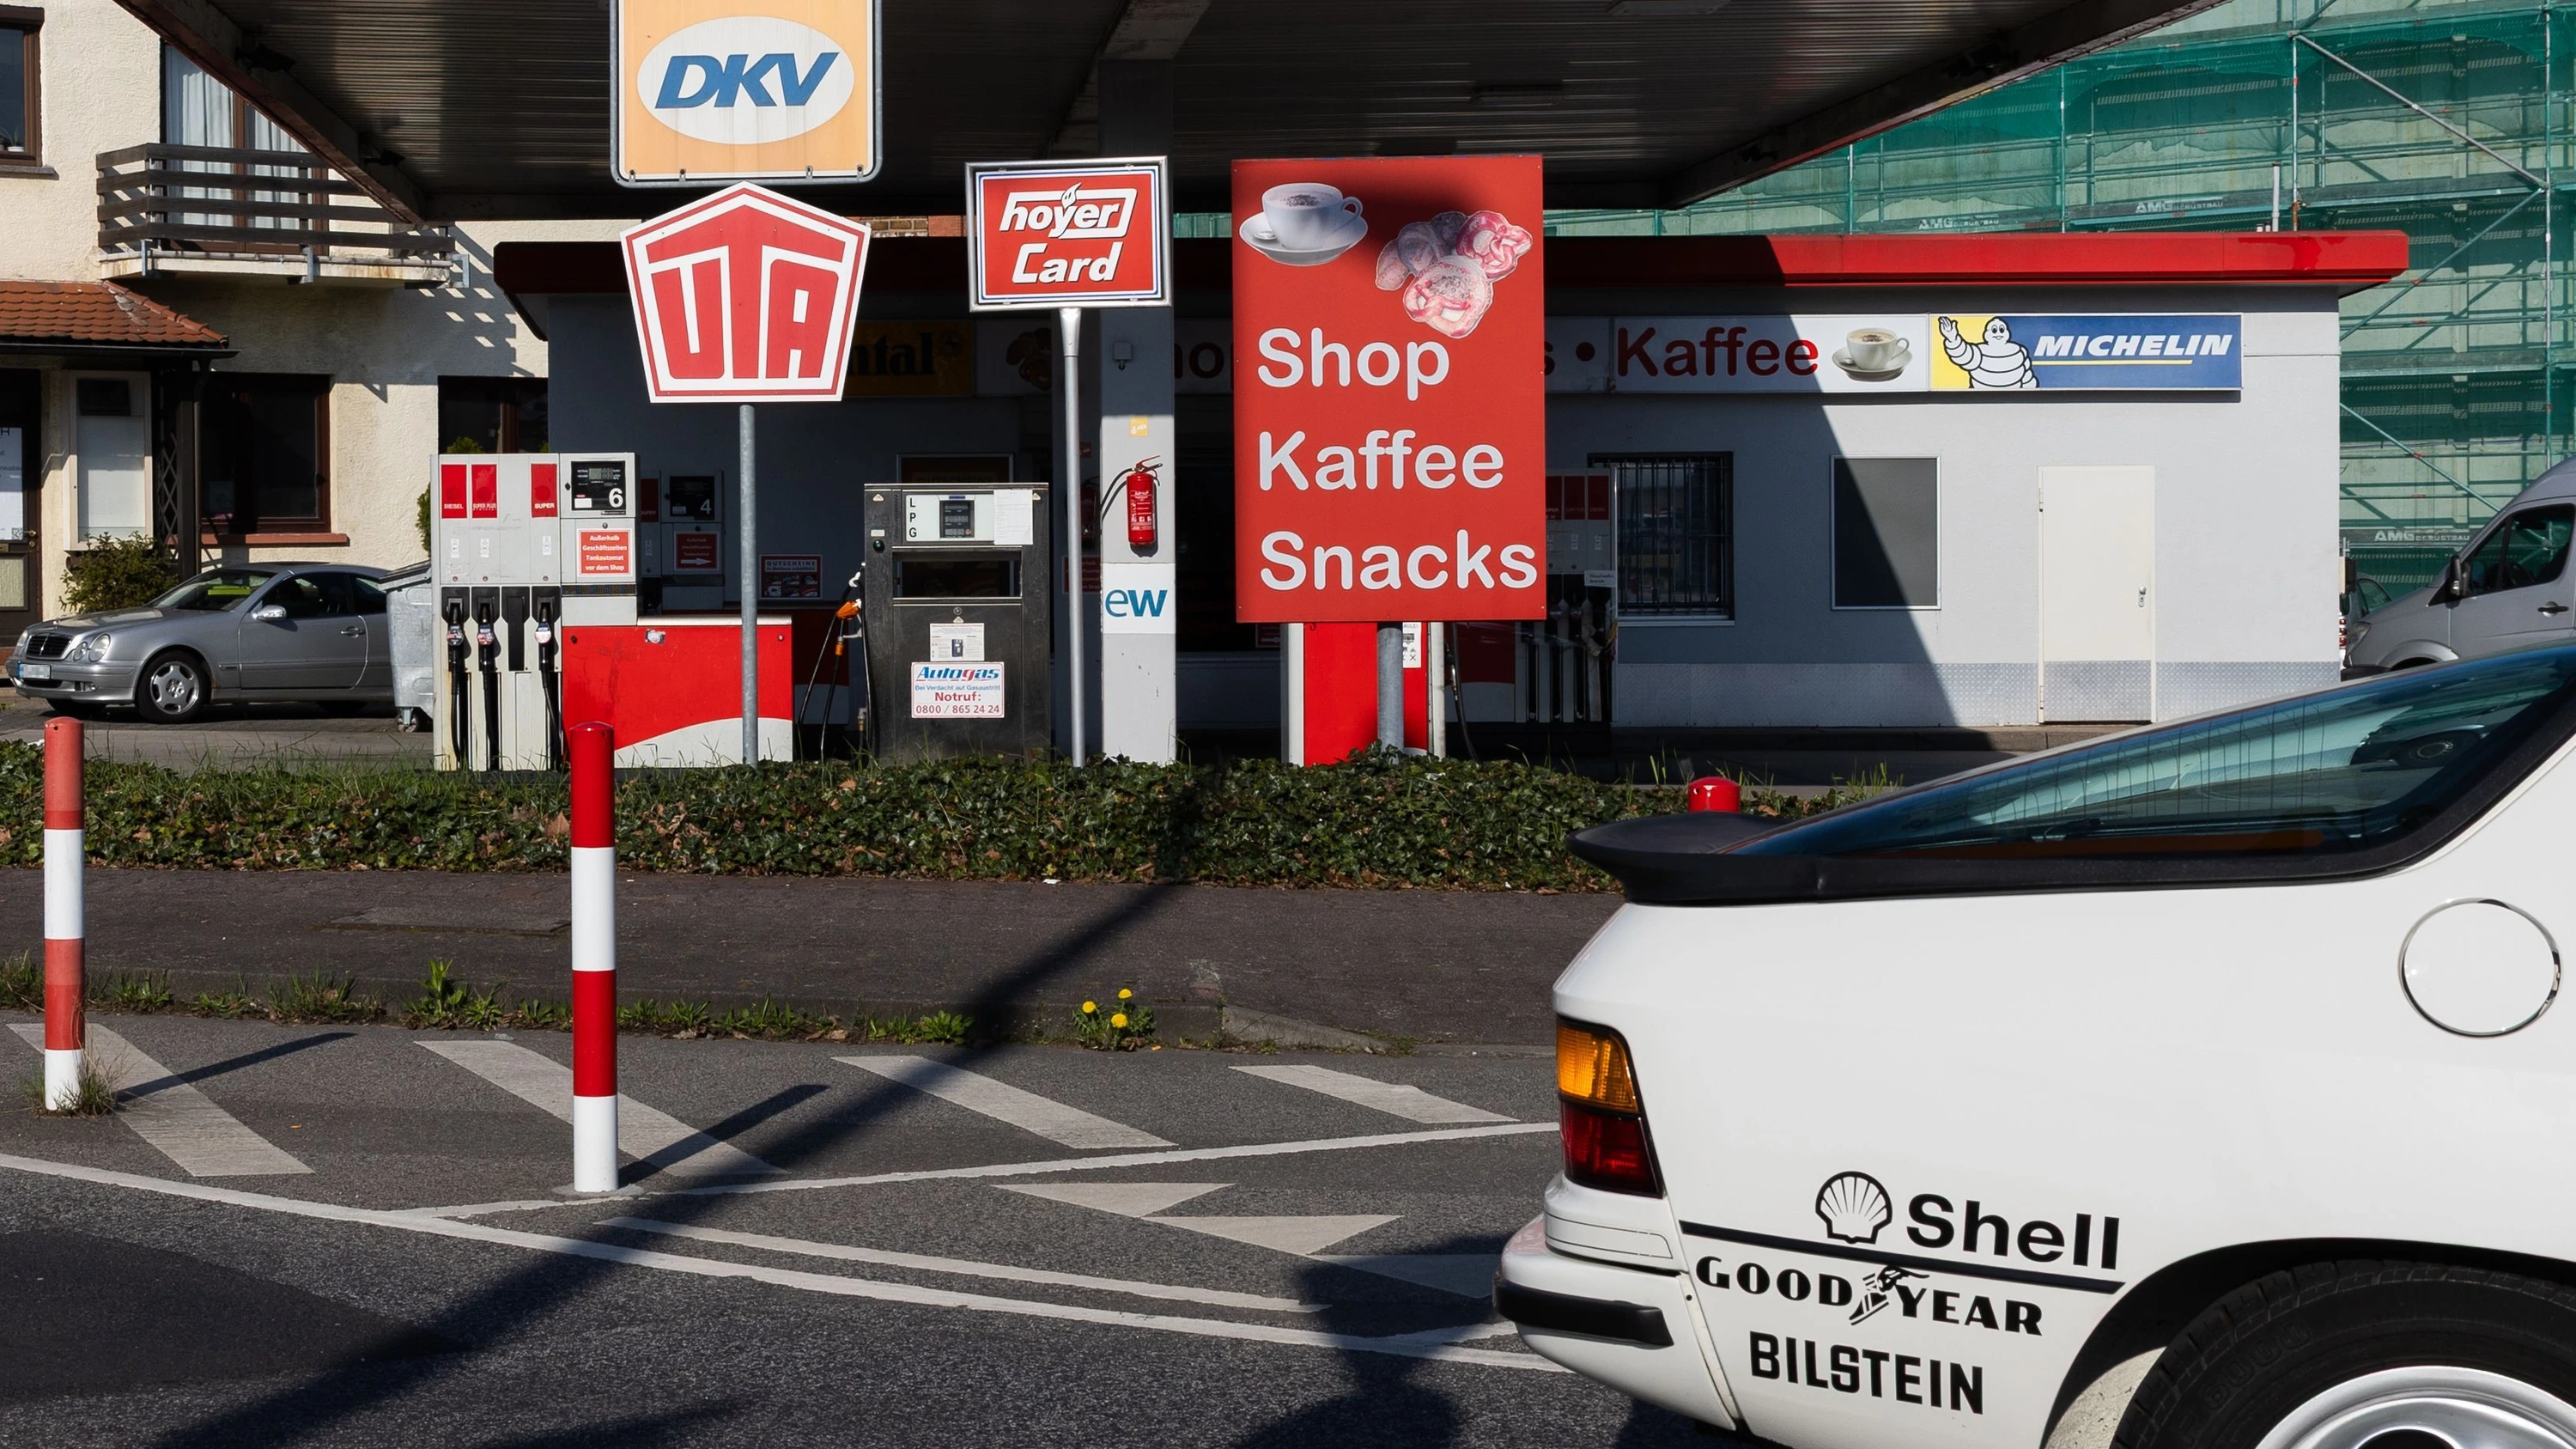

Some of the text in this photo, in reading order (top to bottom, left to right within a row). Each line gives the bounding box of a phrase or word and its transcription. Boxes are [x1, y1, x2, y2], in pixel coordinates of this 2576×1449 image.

[655, 52, 839, 108] DKV
[999, 187, 1121, 239] hoyer
[1918, 217, 1953, 229] AMG
[2136, 200, 2172, 213] AMG
[1012, 241, 1123, 284] Card
[646, 204, 846, 379] UTA
[1618, 326, 1819, 377] Kaffee
[2033, 334, 2233, 356] MICHELIN
[1258, 327, 1449, 401] Shop
[1259, 429, 1504, 491] Kaffee
[609, 488, 623, 508] 6
[700, 498, 712, 514] 4
[2373, 530, 2415, 541] AMG
[1260, 529, 1538, 591] Snacks
[1105, 589, 1168, 618] ew
[917, 667, 999, 681] Autogas
[916, 705, 942, 714] 0800
[952, 705, 971, 714] 865
[974, 705, 985, 714] 24
[987, 705, 999, 714] 24
[935, 691, 981, 702] Notruf:
[1907, 1193, 2120, 1270] Shell
[1749, 1331, 1984, 1415] BILSTEIN
